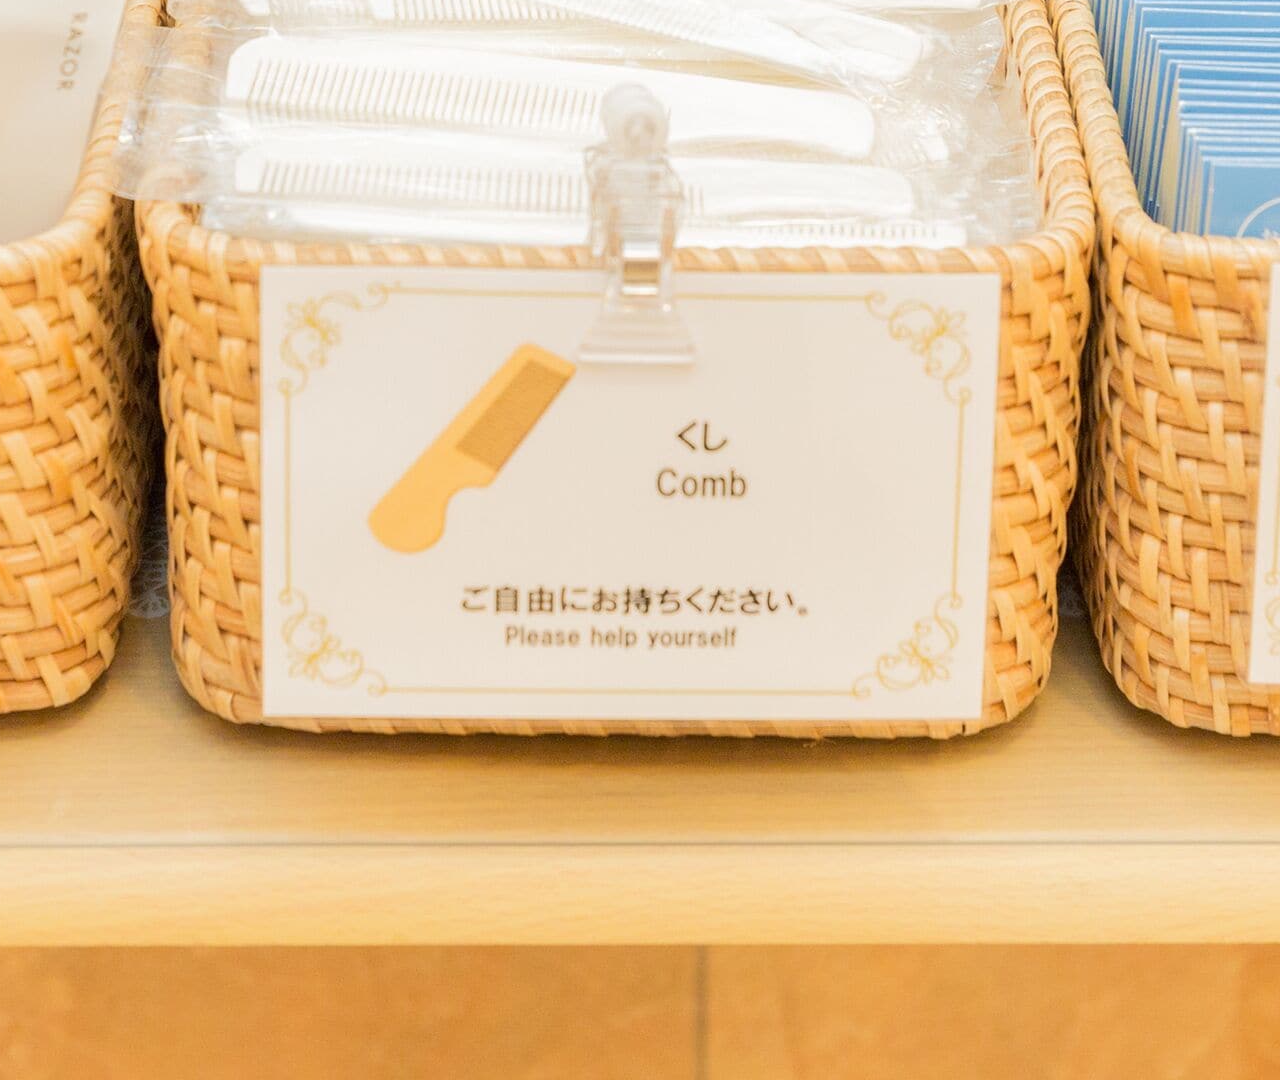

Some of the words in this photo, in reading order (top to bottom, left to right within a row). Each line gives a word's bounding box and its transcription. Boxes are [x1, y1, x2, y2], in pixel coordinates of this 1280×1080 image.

[56, 11, 89, 91] RAZOR
[677, 421, 728, 453] くし
[656, 468, 748, 498] Comb
[462, 585, 807, 615] ご自由にお持ちください。
[505, 626, 580, 648] Please
[590, 626, 637, 649] help
[647, 626, 738, 649] yourself
